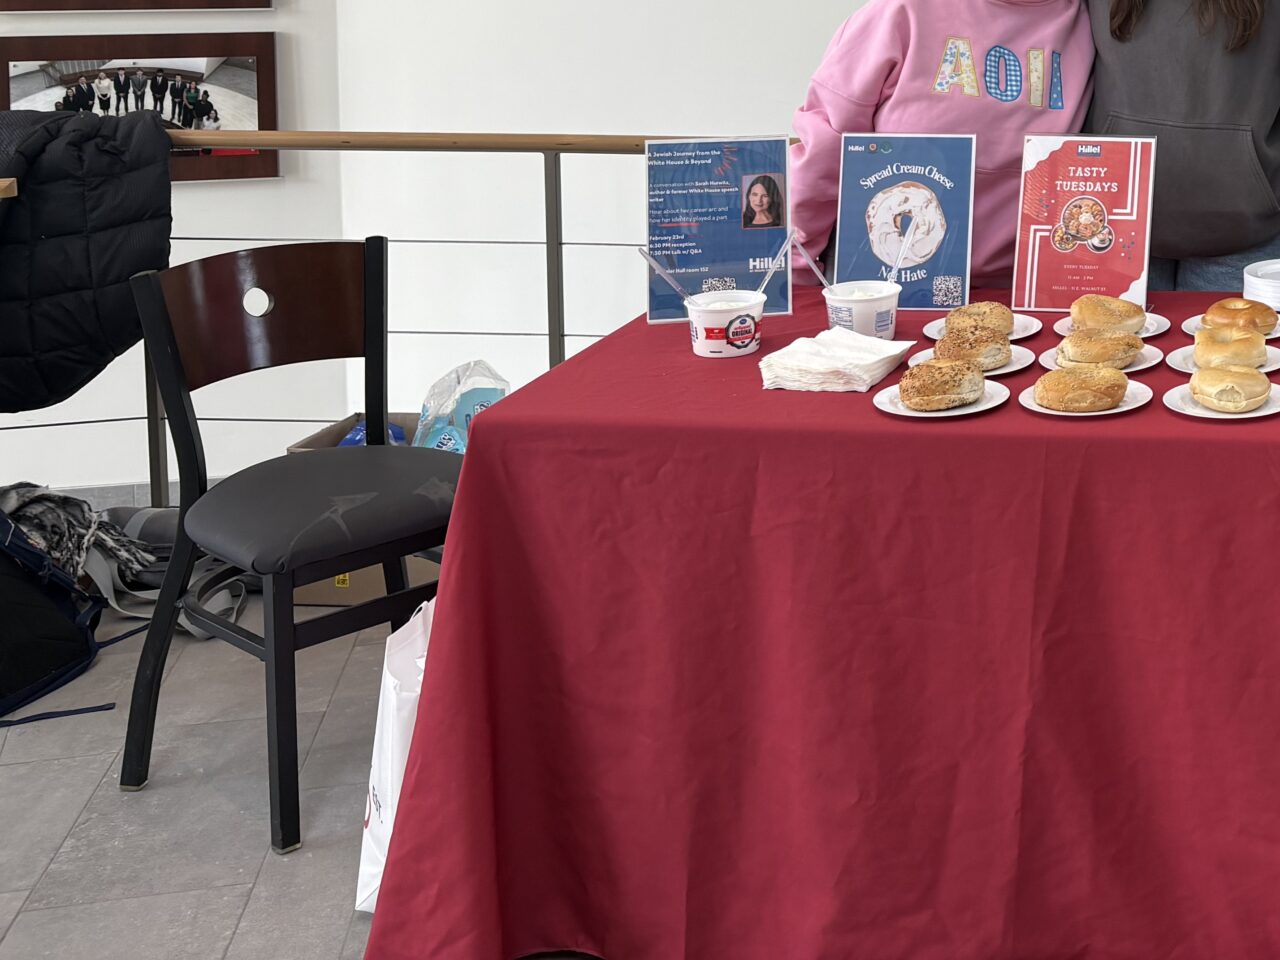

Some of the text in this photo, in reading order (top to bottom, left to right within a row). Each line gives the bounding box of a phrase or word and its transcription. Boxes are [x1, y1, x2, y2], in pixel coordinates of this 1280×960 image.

[1078, 144, 1100, 154] Hillel
[690, 158, 712, 166] Beyond
[860, 162, 954, 190] Spread Cream Cheese
[1068, 166, 1108, 177] TASTY
[1055, 181, 1118, 192] TUESDAYS
[901, 268, 928, 282] Hate
[732, 329, 752, 338] ORIGINAL
